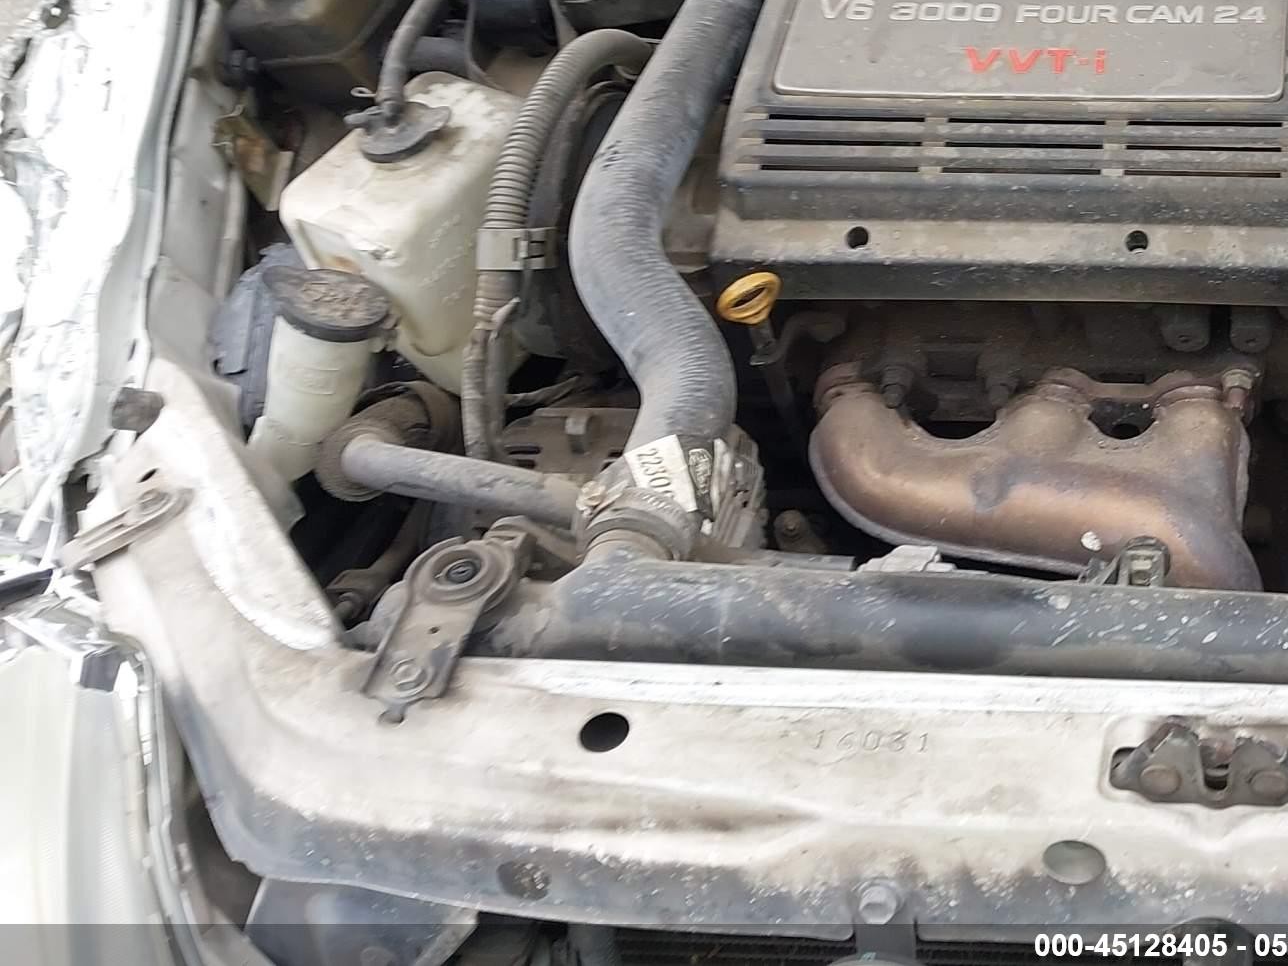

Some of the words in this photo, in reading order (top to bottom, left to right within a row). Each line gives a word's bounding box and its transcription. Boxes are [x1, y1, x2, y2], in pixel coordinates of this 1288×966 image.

[889, 1, 1002, 23] 3000
[1015, 4, 1119, 25] FOUR
[1125, 5, 1205, 25] CAM
[1213, 5, 1267, 25] 24
[964, 46, 1107, 75] VVT-i
